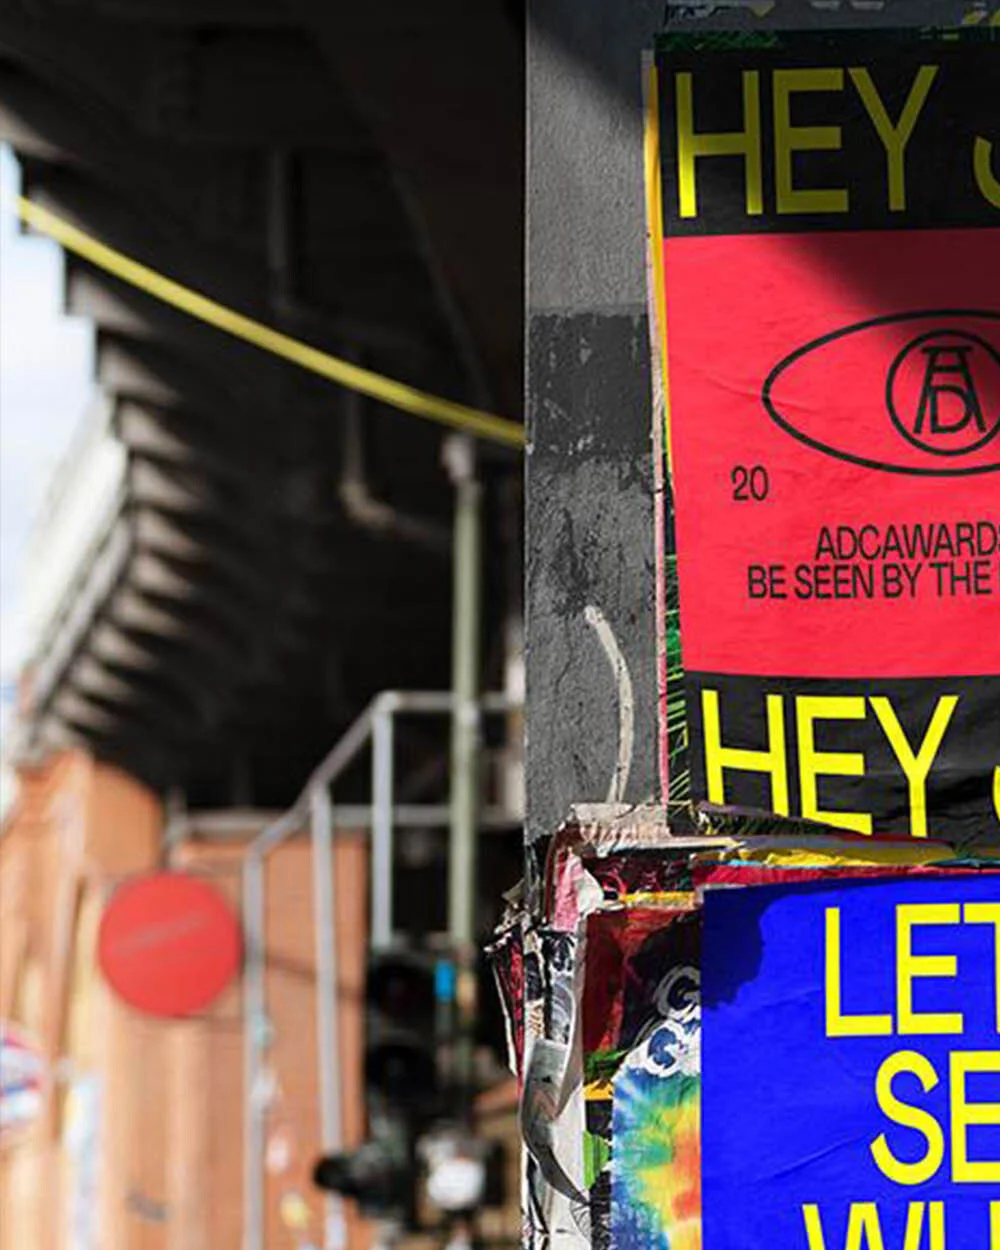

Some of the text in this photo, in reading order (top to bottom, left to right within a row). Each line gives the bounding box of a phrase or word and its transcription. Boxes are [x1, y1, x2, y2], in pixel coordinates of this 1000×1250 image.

[677, 66, 938, 219] HEY
[731, 465, 769, 501] 20
[748, 564, 787, 599] BE
[794, 562, 875, 599] SEEN
[882, 562, 922, 598] BY
[929, 560, 992, 597] THE
[701, 689, 959, 838] HEY
